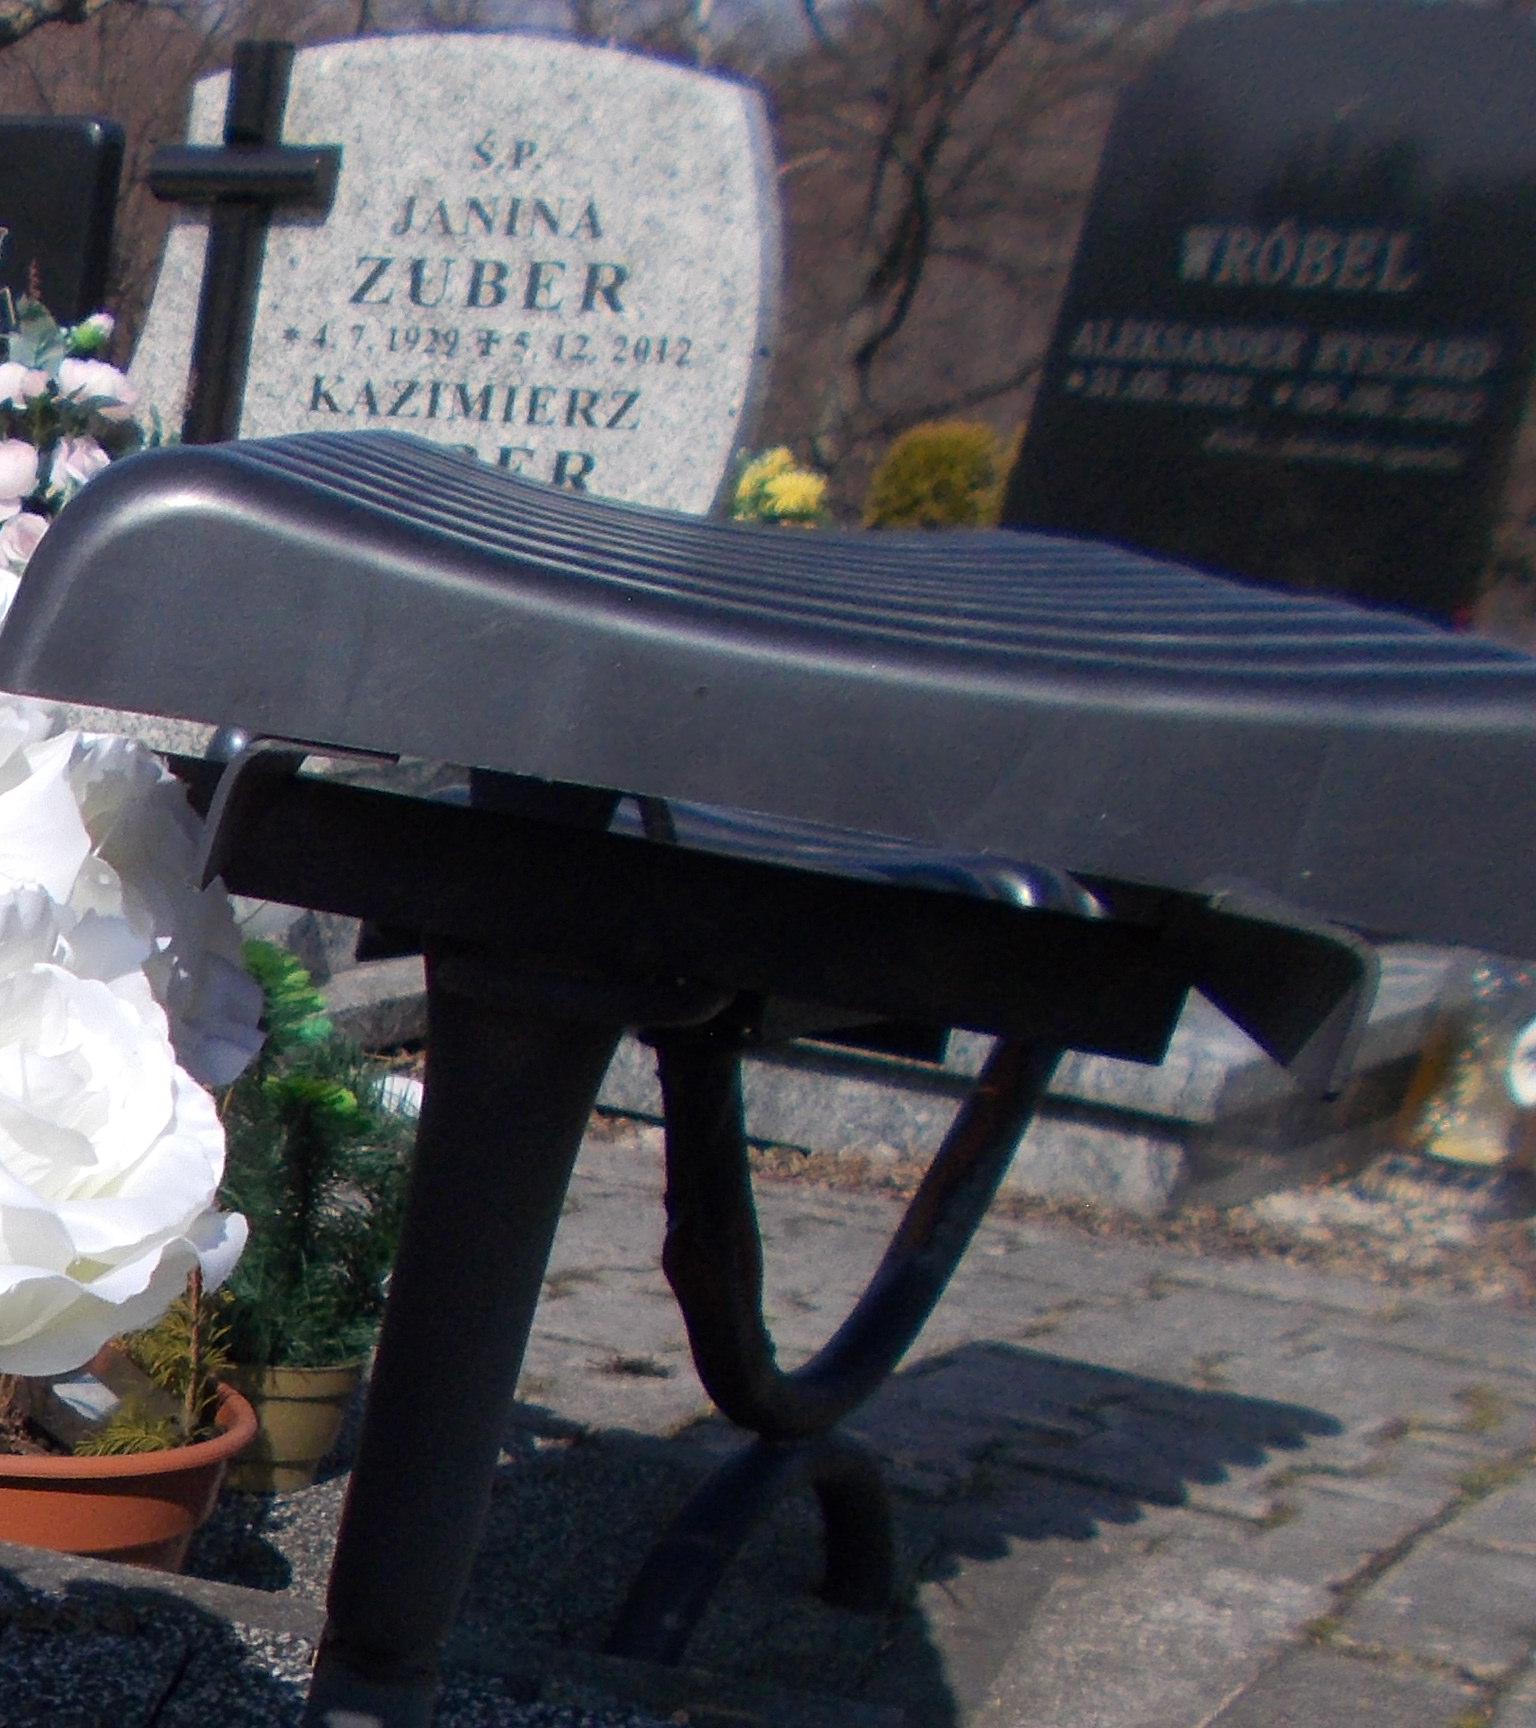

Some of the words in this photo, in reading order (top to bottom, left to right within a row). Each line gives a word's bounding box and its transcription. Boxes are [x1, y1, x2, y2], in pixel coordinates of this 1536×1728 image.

[392, 195, 604, 239] JANINA
[349, 255, 632, 315] ZUBER
[308, 376, 642, 432] KAZIMIERZ
